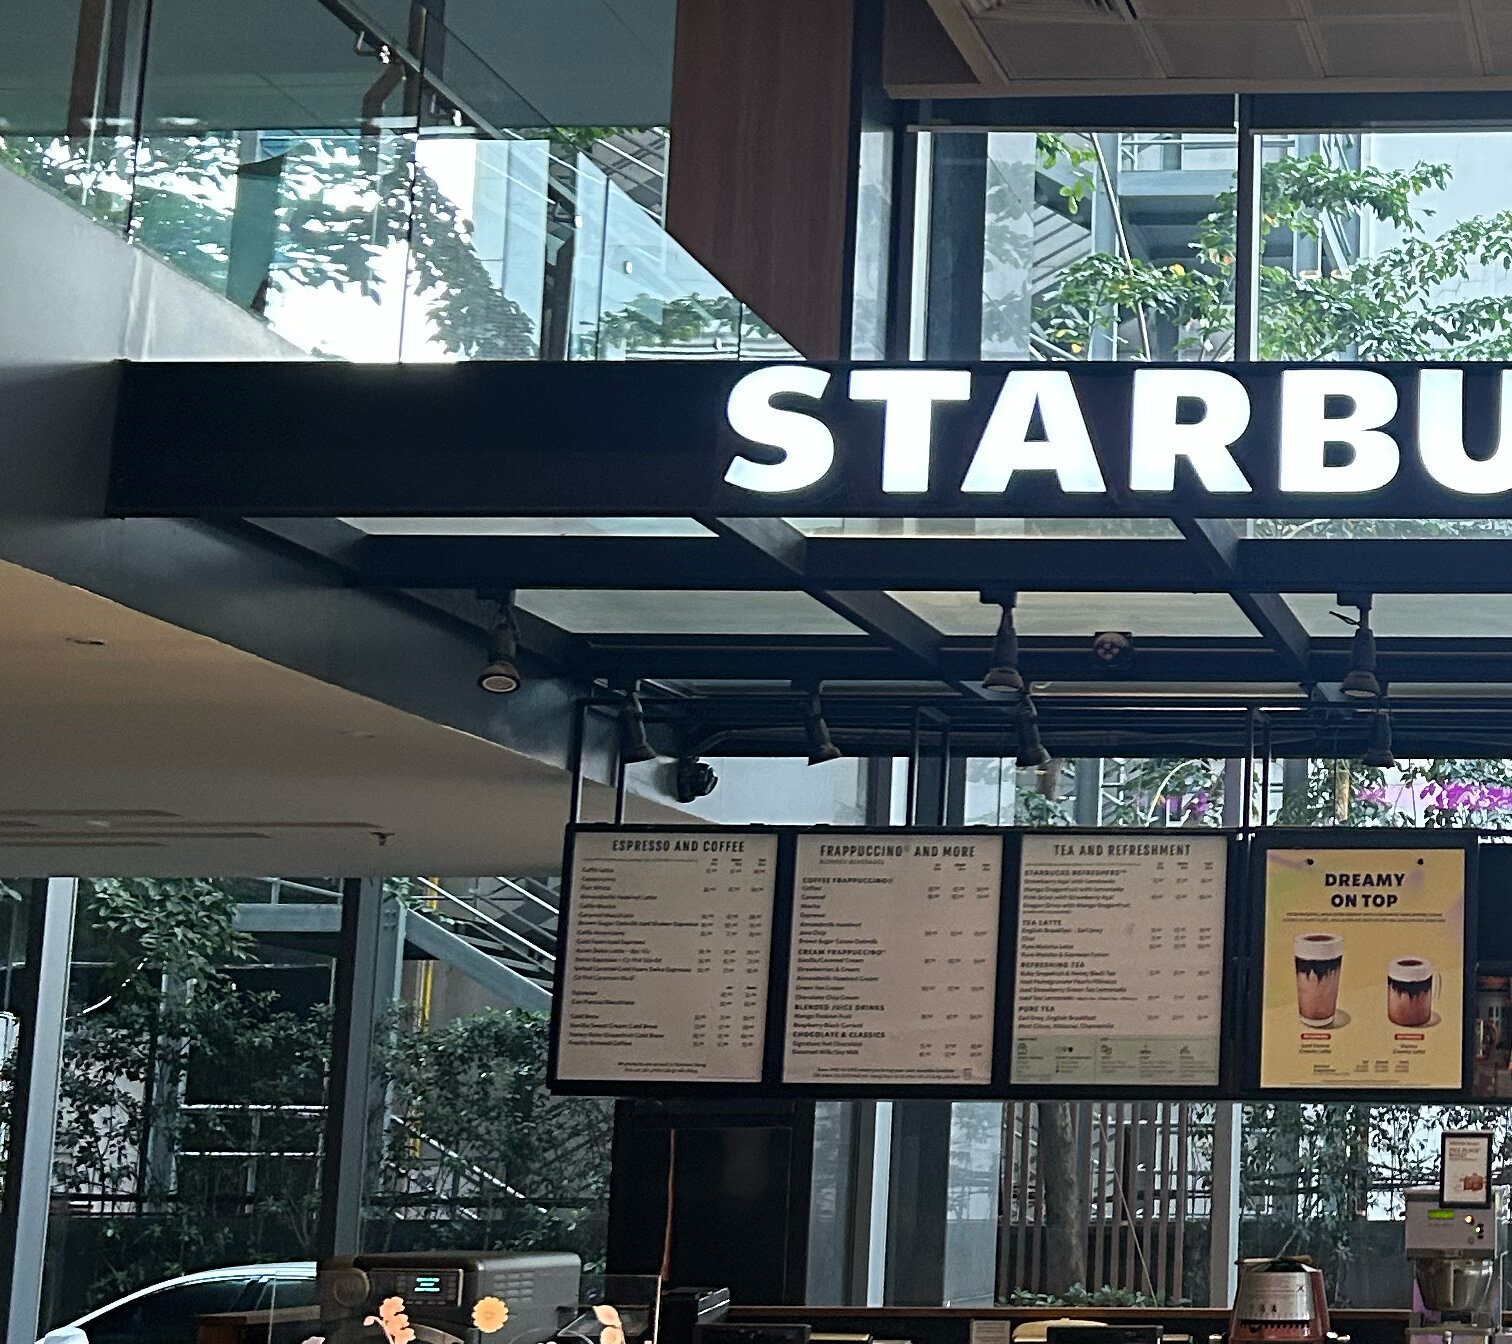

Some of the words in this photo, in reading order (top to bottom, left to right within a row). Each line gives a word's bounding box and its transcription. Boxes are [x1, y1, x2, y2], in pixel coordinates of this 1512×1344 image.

[612, 839, 671, 852] ESPRESSO
[673, 839, 699, 852] AND
[703, 840, 745, 853] COFFEE
[914, 845, 939, 857] AND
[942, 845, 976, 857] MORE
[1053, 844, 1075, 857] TEA
[1078, 844, 1104, 857] AND
[1107, 844, 1192, 857] REFRESHMENT
[1324, 873, 1406, 887] DREAMY
[1330, 894, 1358, 907] ON
[1361, 894, 1399, 907] TOP
